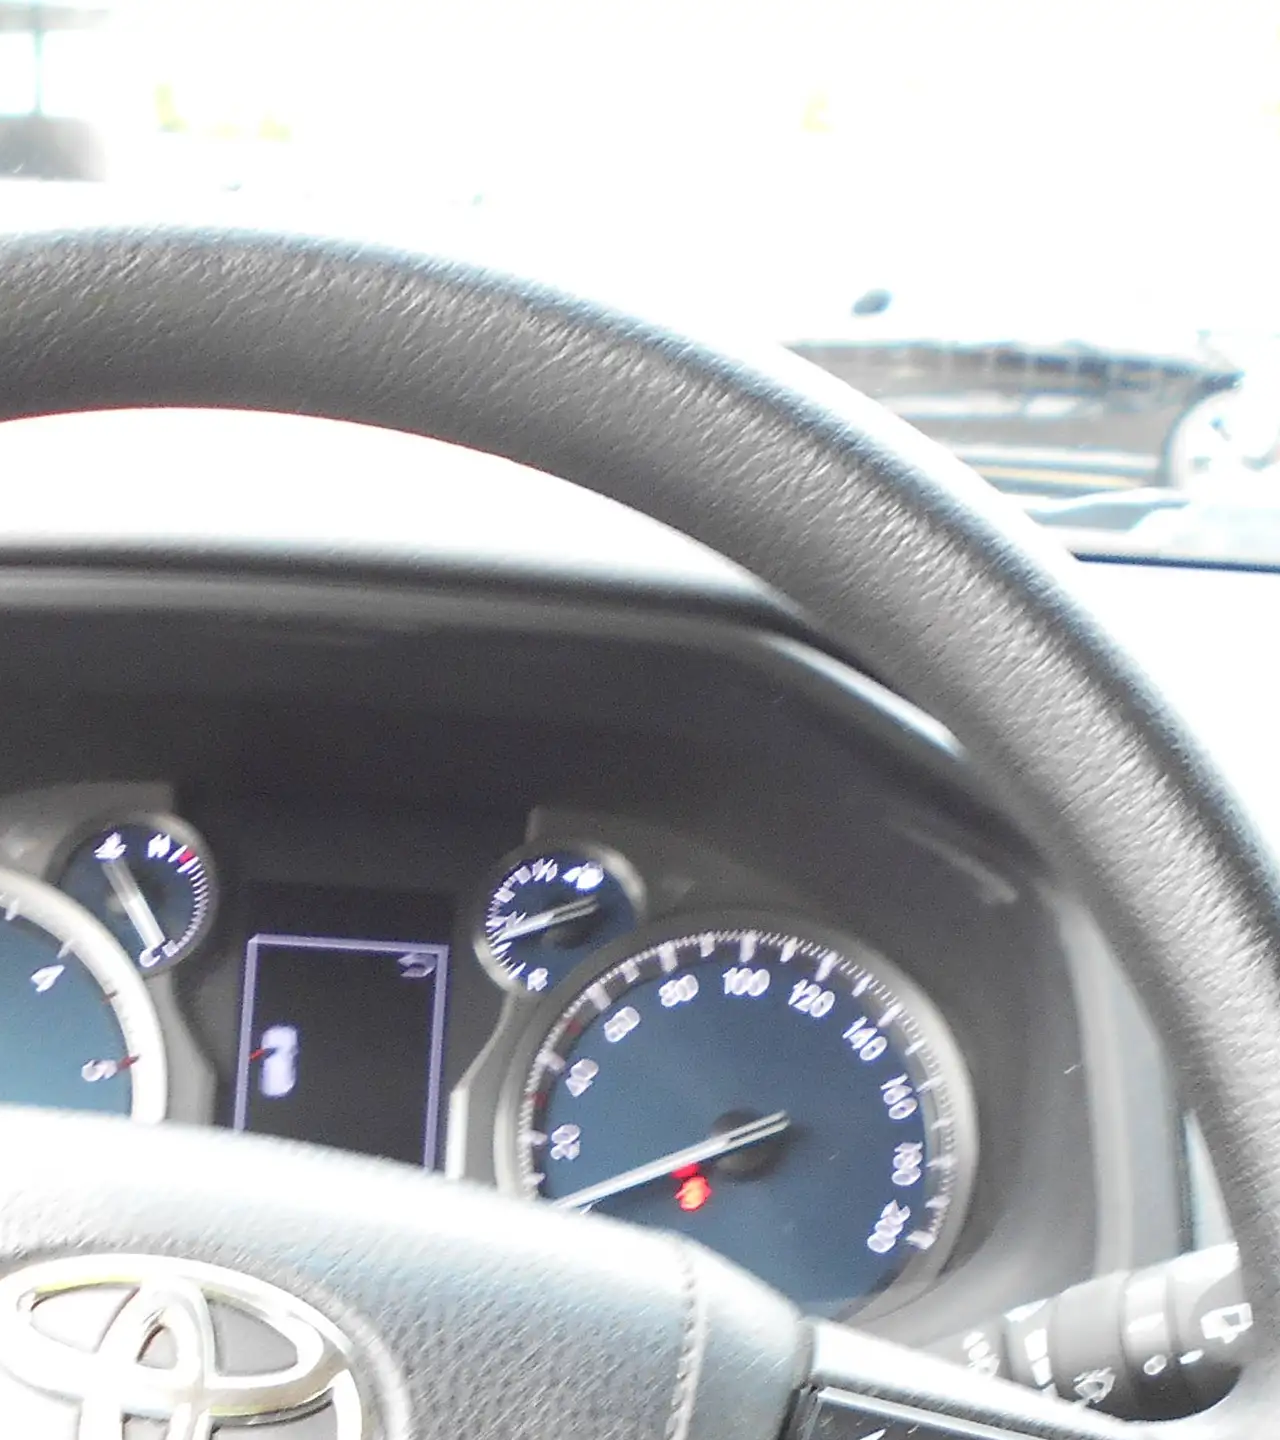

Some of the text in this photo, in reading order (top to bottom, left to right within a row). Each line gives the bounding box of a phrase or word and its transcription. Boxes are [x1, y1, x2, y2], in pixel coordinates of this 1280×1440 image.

[31, 963, 65, 993] 4
[658, 973, 700, 1008] 80
[722, 966, 771, 998] 100
[788, 978, 836, 1018] 120
[842, 1016, 888, 1062] 140
[879, 1072, 919, 1121] 160
